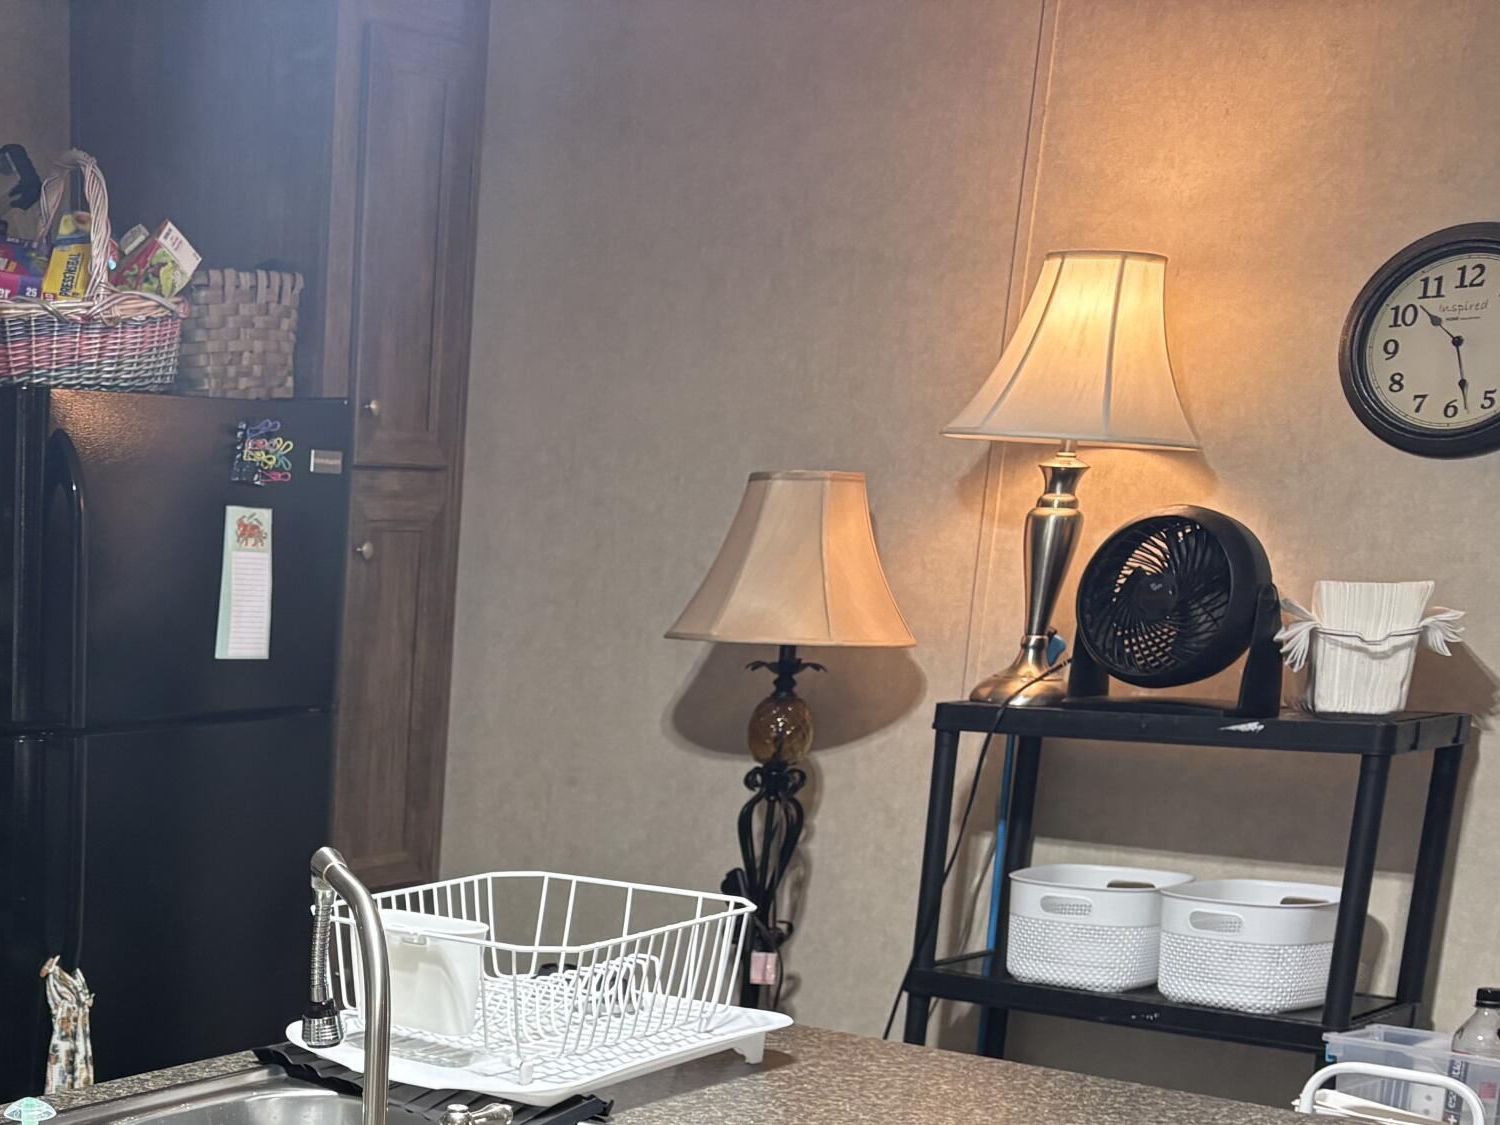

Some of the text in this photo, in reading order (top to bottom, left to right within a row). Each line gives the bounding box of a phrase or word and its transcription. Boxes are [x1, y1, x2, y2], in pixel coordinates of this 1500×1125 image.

[1454, 263, 1486, 288] 12
[1417, 275, 1445, 299] 11
[1388, 303, 1418, 328] 10
[1382, 338, 1400, 361] 9
[1388, 372, 1404, 393] 8
[1412, 394, 1428, 413] 7
[1443, 399, 1459, 418] 6
[1480, 389, 1497, 409] 5
